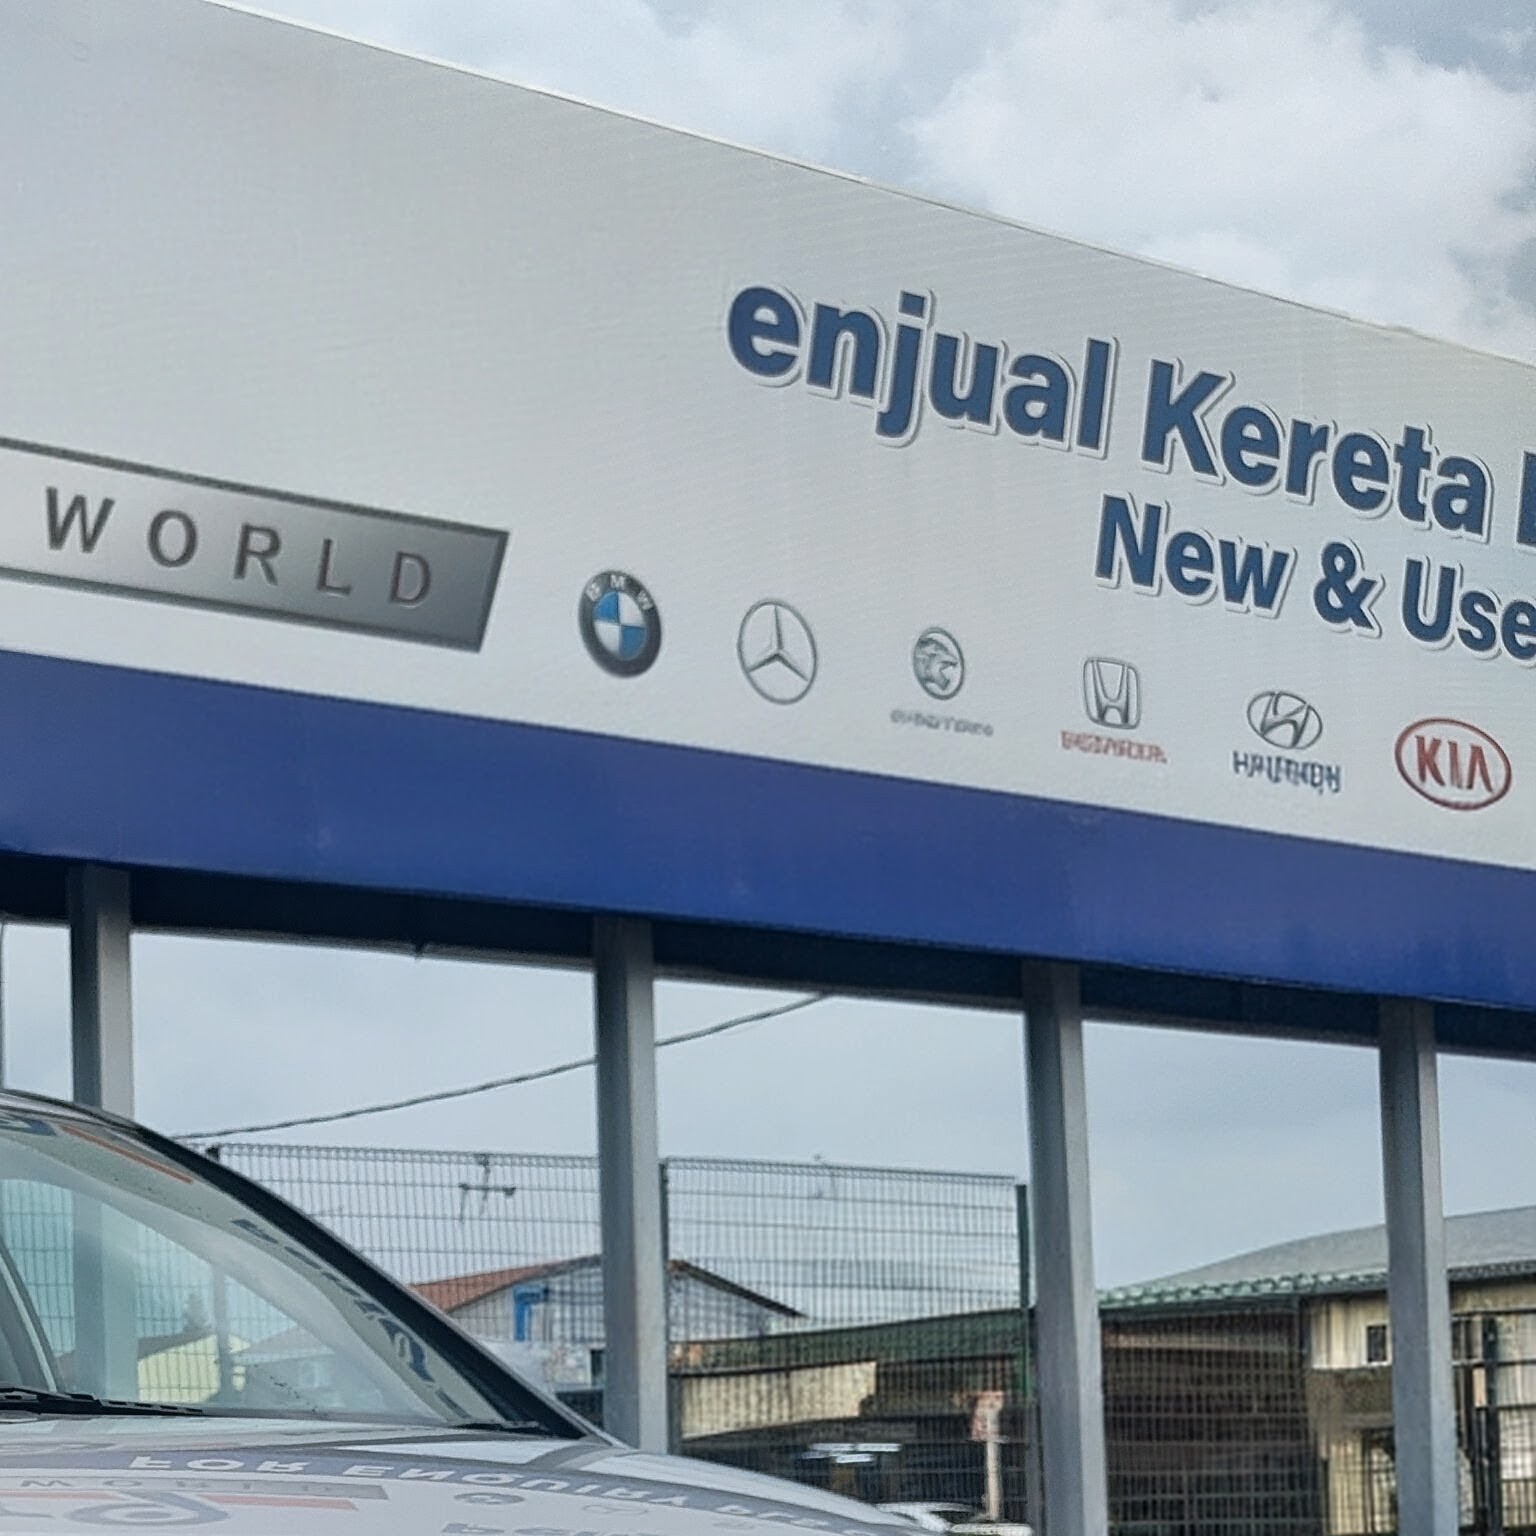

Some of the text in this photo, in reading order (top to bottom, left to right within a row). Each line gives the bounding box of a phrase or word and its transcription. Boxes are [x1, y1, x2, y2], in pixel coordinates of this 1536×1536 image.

[728, 286, 1110, 446] enjual
[1143, 360, 1487, 536] Kereta
[46, 486, 432, 608] WORLD
[1097, 495, 1536, 660] New & Use
[1415, 734, 1493, 793] KIA
